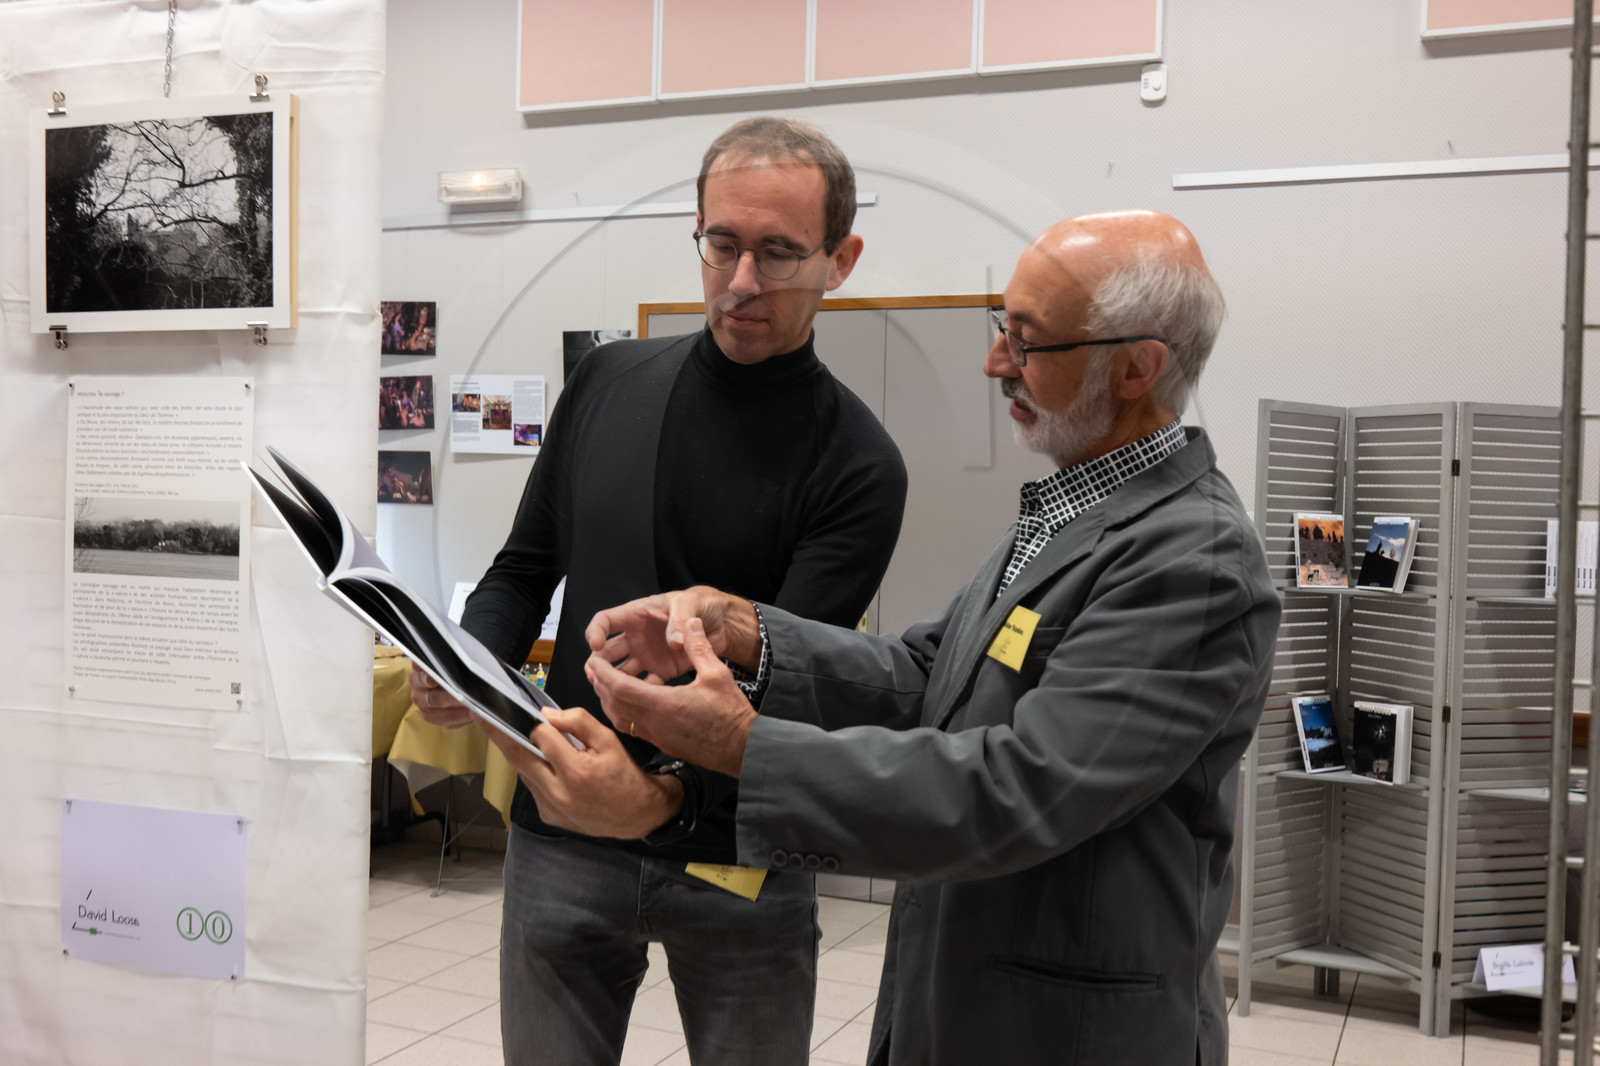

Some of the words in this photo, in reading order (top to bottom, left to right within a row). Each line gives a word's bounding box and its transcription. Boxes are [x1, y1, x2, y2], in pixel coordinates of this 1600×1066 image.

[78, 905, 107, 922] David
[112, 909, 141, 927] Loose
[180, 909, 230, 942] 10
